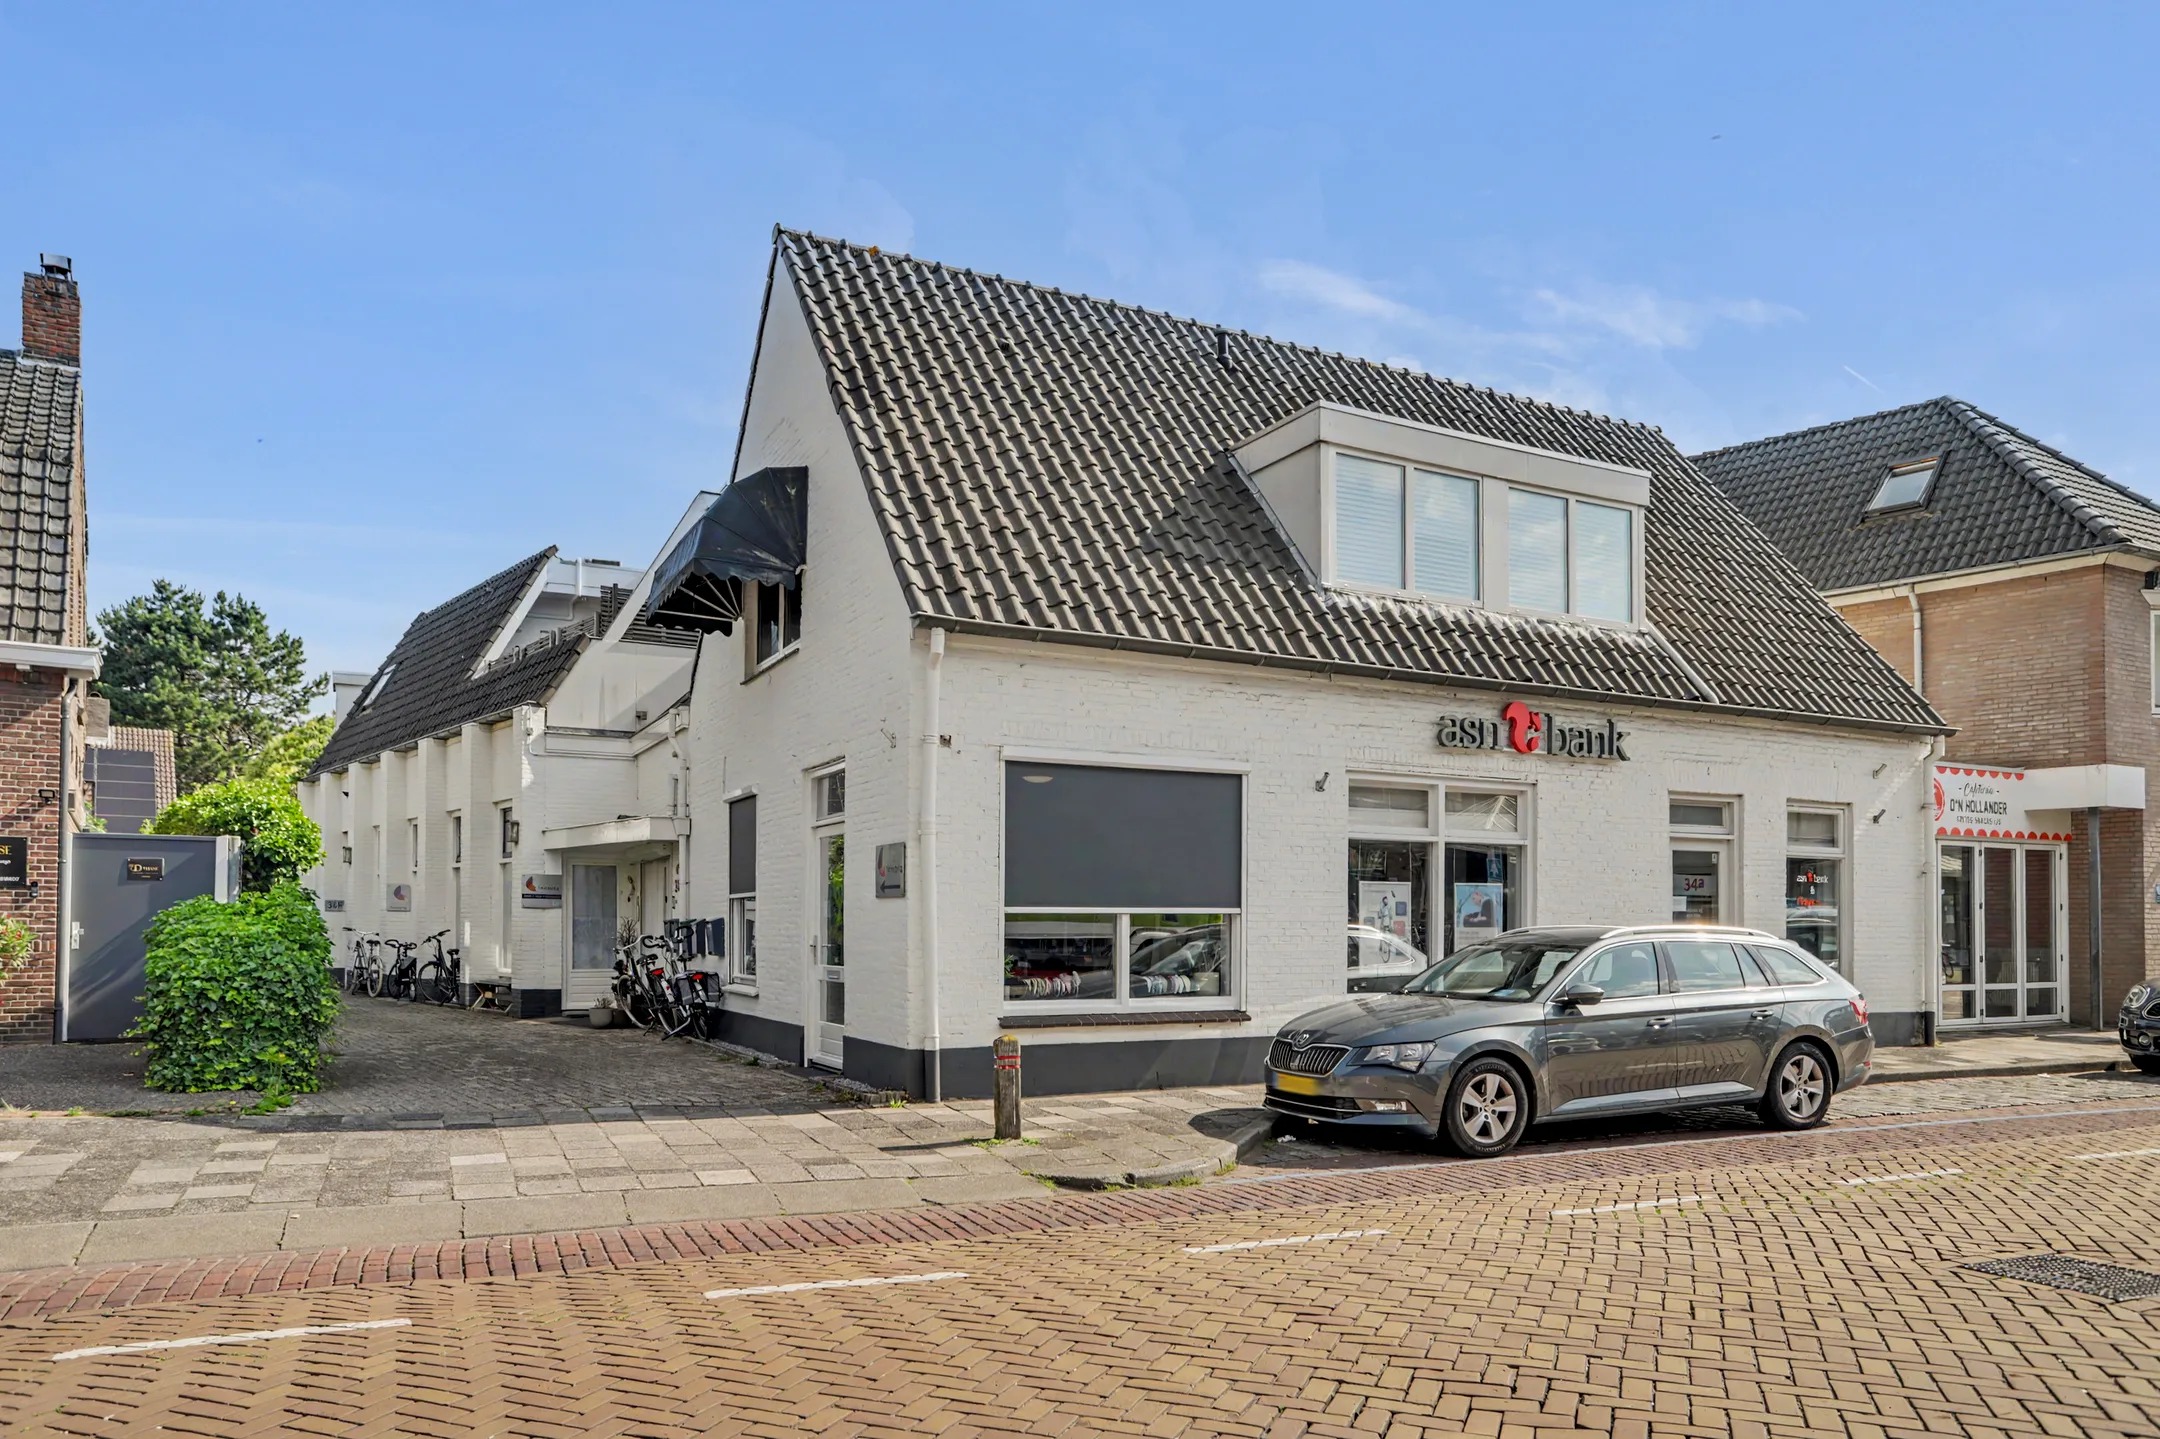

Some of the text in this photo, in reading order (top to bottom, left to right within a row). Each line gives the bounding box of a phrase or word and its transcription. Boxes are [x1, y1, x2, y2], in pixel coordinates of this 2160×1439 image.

[1438, 713, 1631, 761] asn bank
[1965, 800, 2008, 815] HOLLANDER
[1683, 877, 1705, 891] 34a
